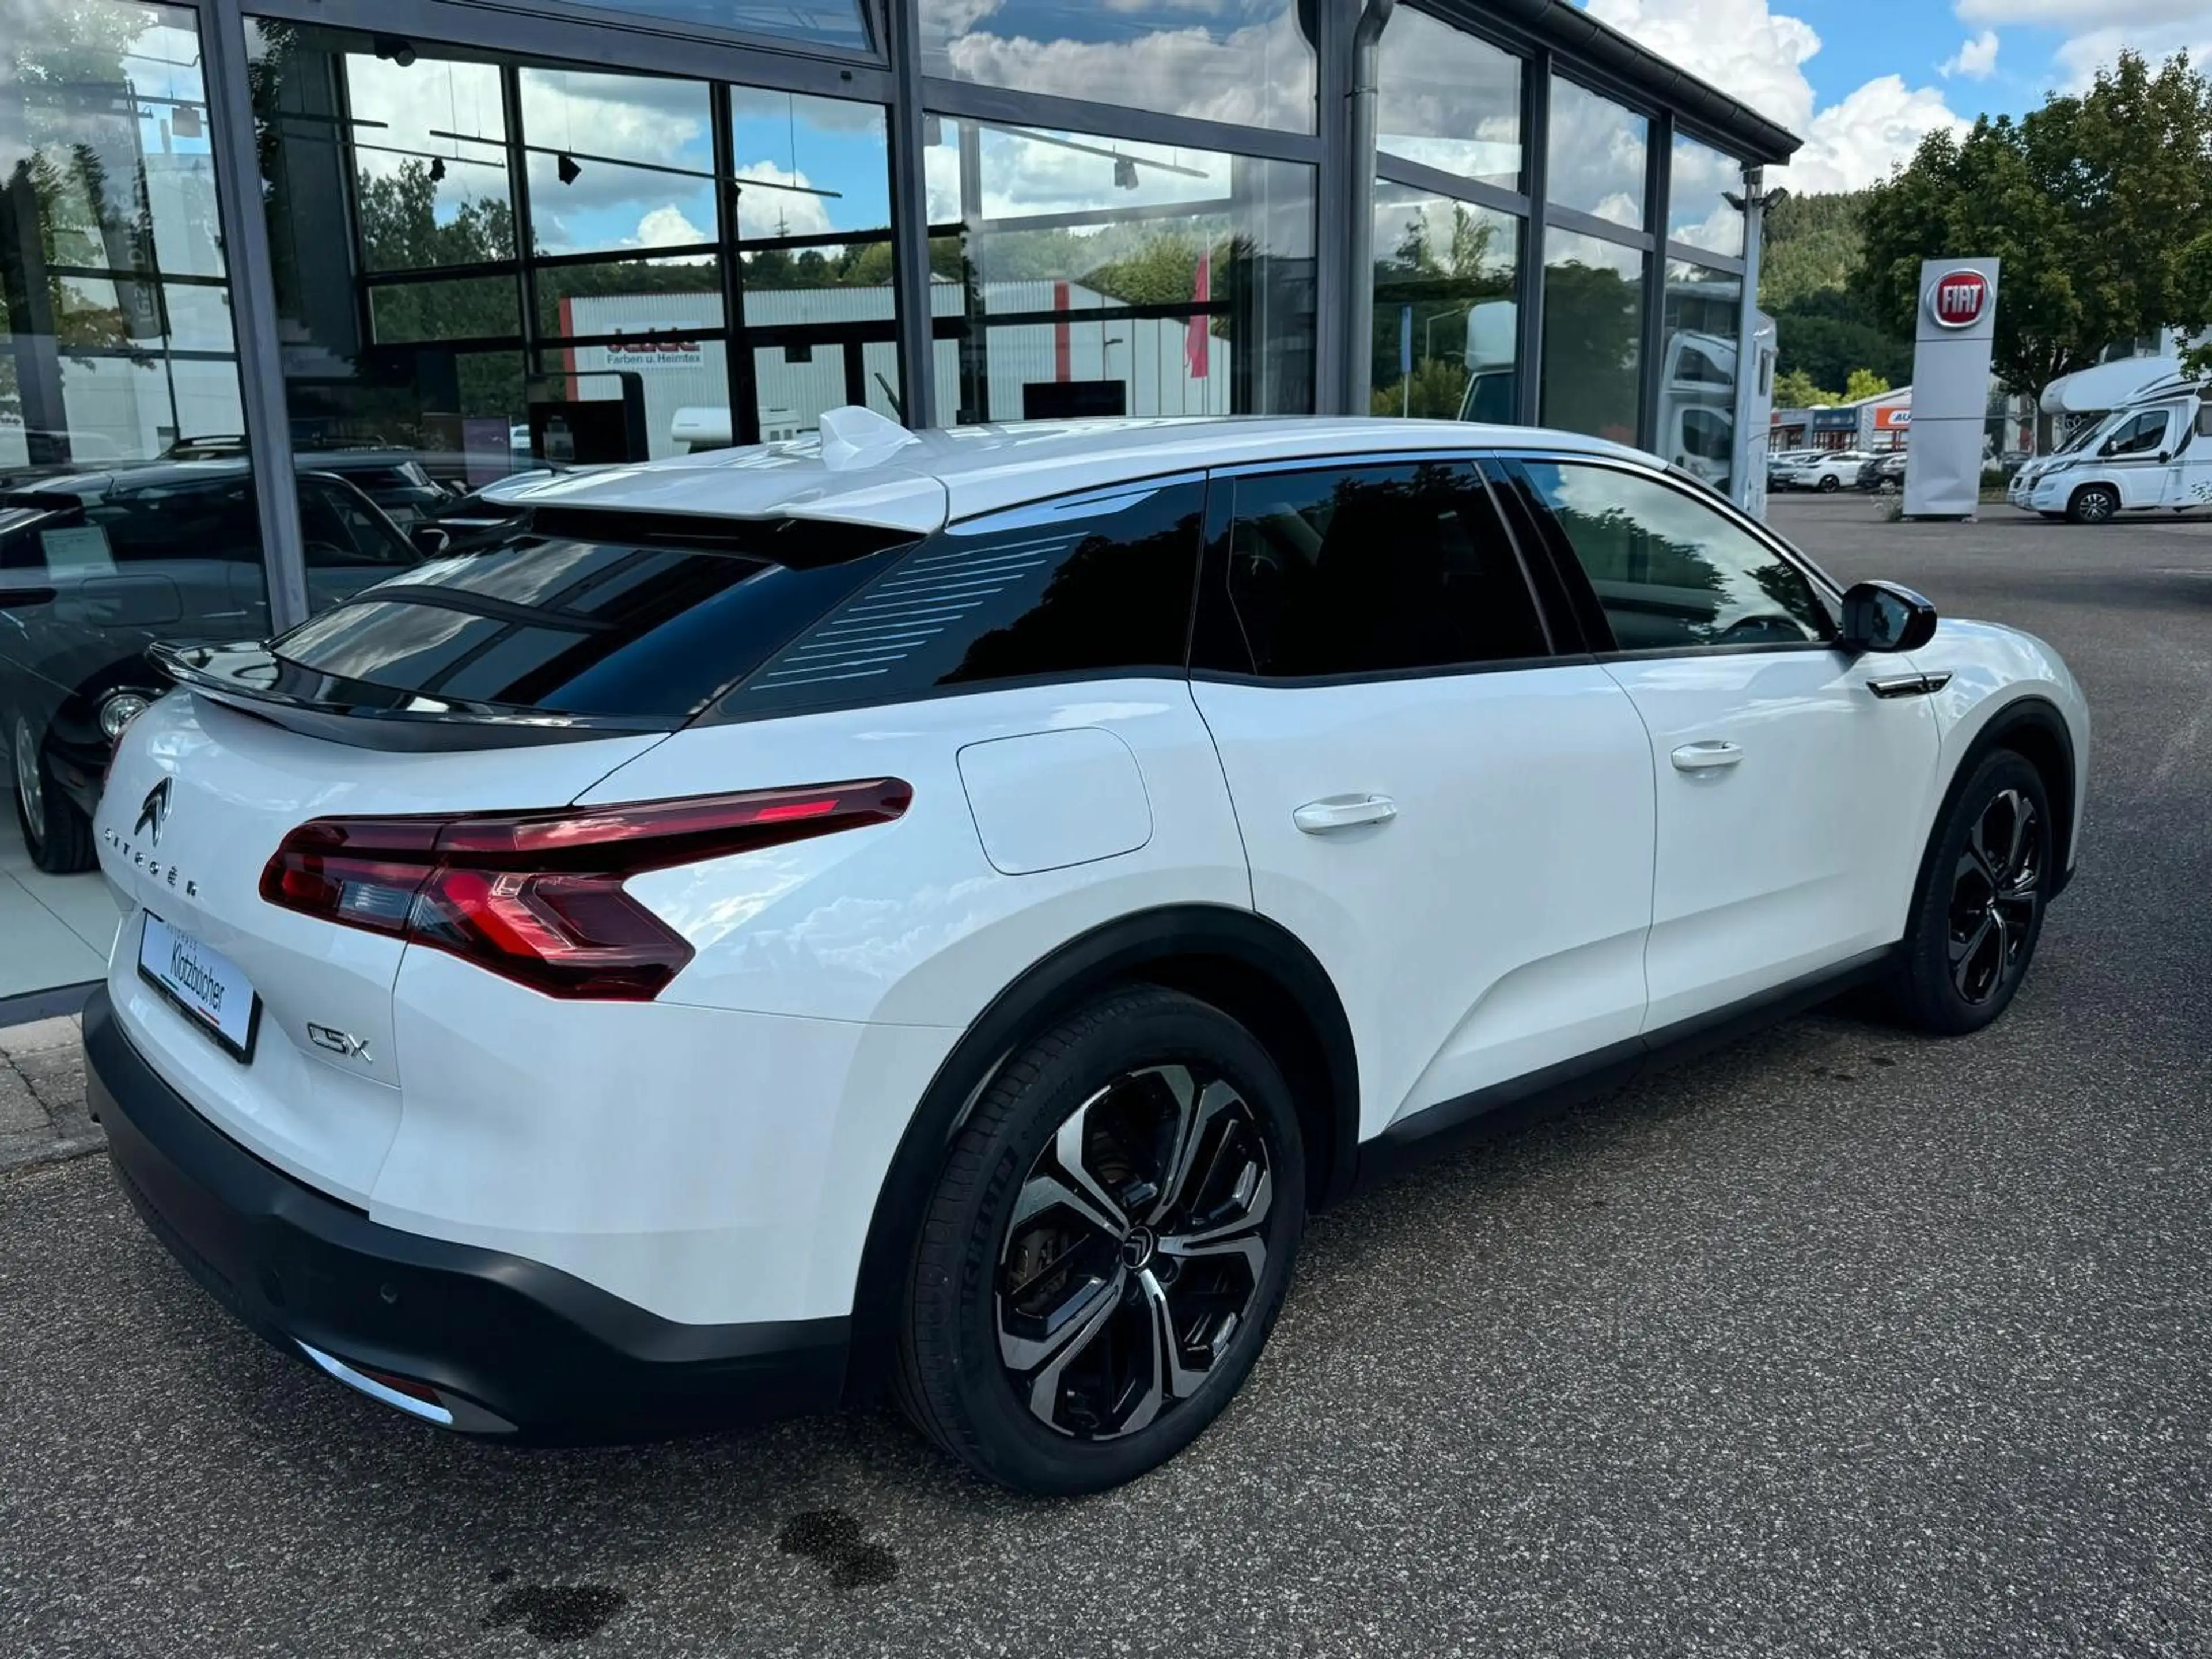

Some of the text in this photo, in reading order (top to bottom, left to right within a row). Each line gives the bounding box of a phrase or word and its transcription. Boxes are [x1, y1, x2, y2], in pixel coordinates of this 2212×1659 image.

[1942, 284, 1982, 314] FIAT
[607, 354, 644, 364] Farben
[657, 352, 700, 363] Heimtex
